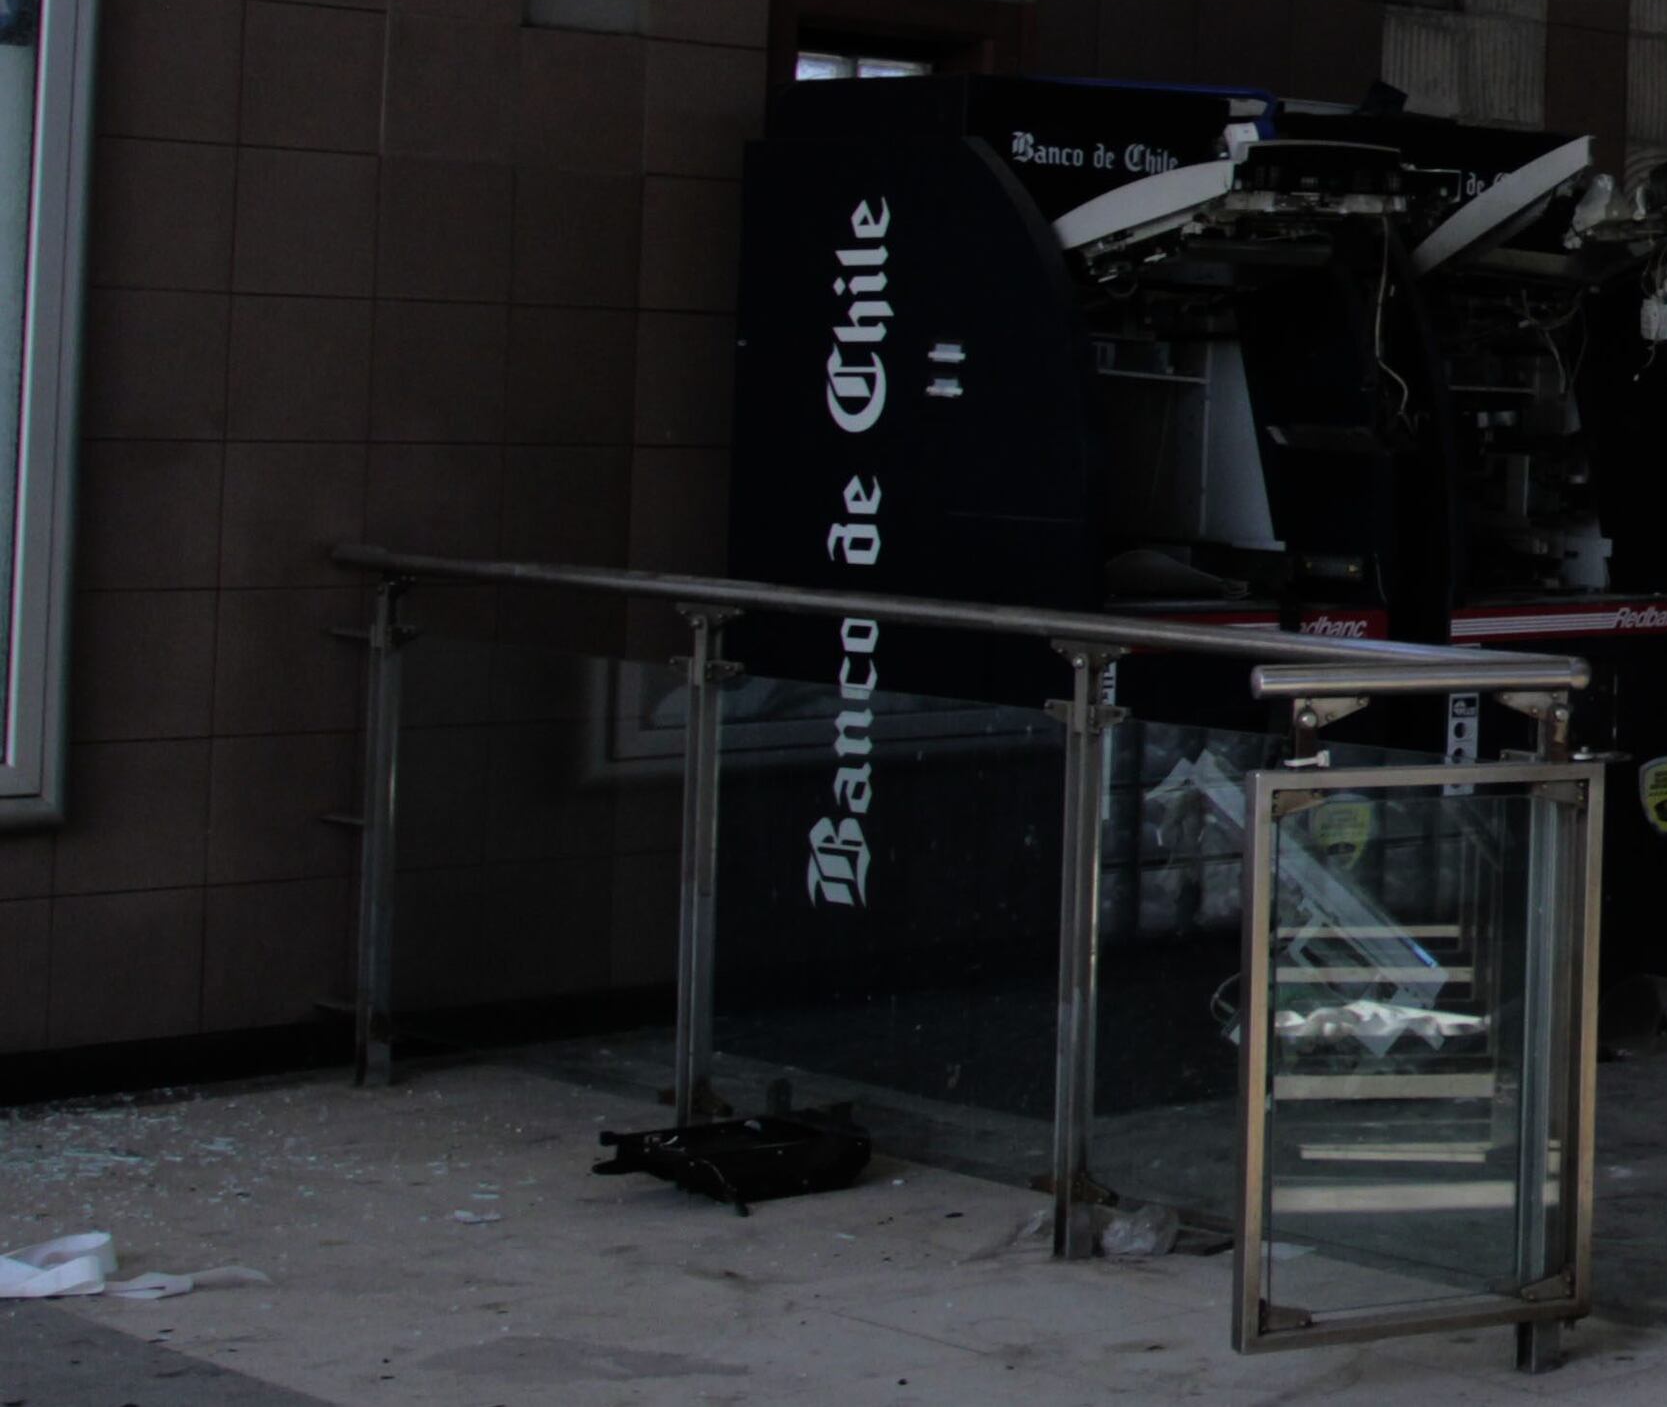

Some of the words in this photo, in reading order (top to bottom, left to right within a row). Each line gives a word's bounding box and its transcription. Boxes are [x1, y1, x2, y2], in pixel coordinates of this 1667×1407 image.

[1012, 131, 1084, 166] Banco
[1093, 143, 1115, 169] de
[1124, 143, 1179, 174] Chile
[826, 196, 895, 433] Chile
[827, 474, 883, 566] de
[807, 618, 880, 908] Banco
